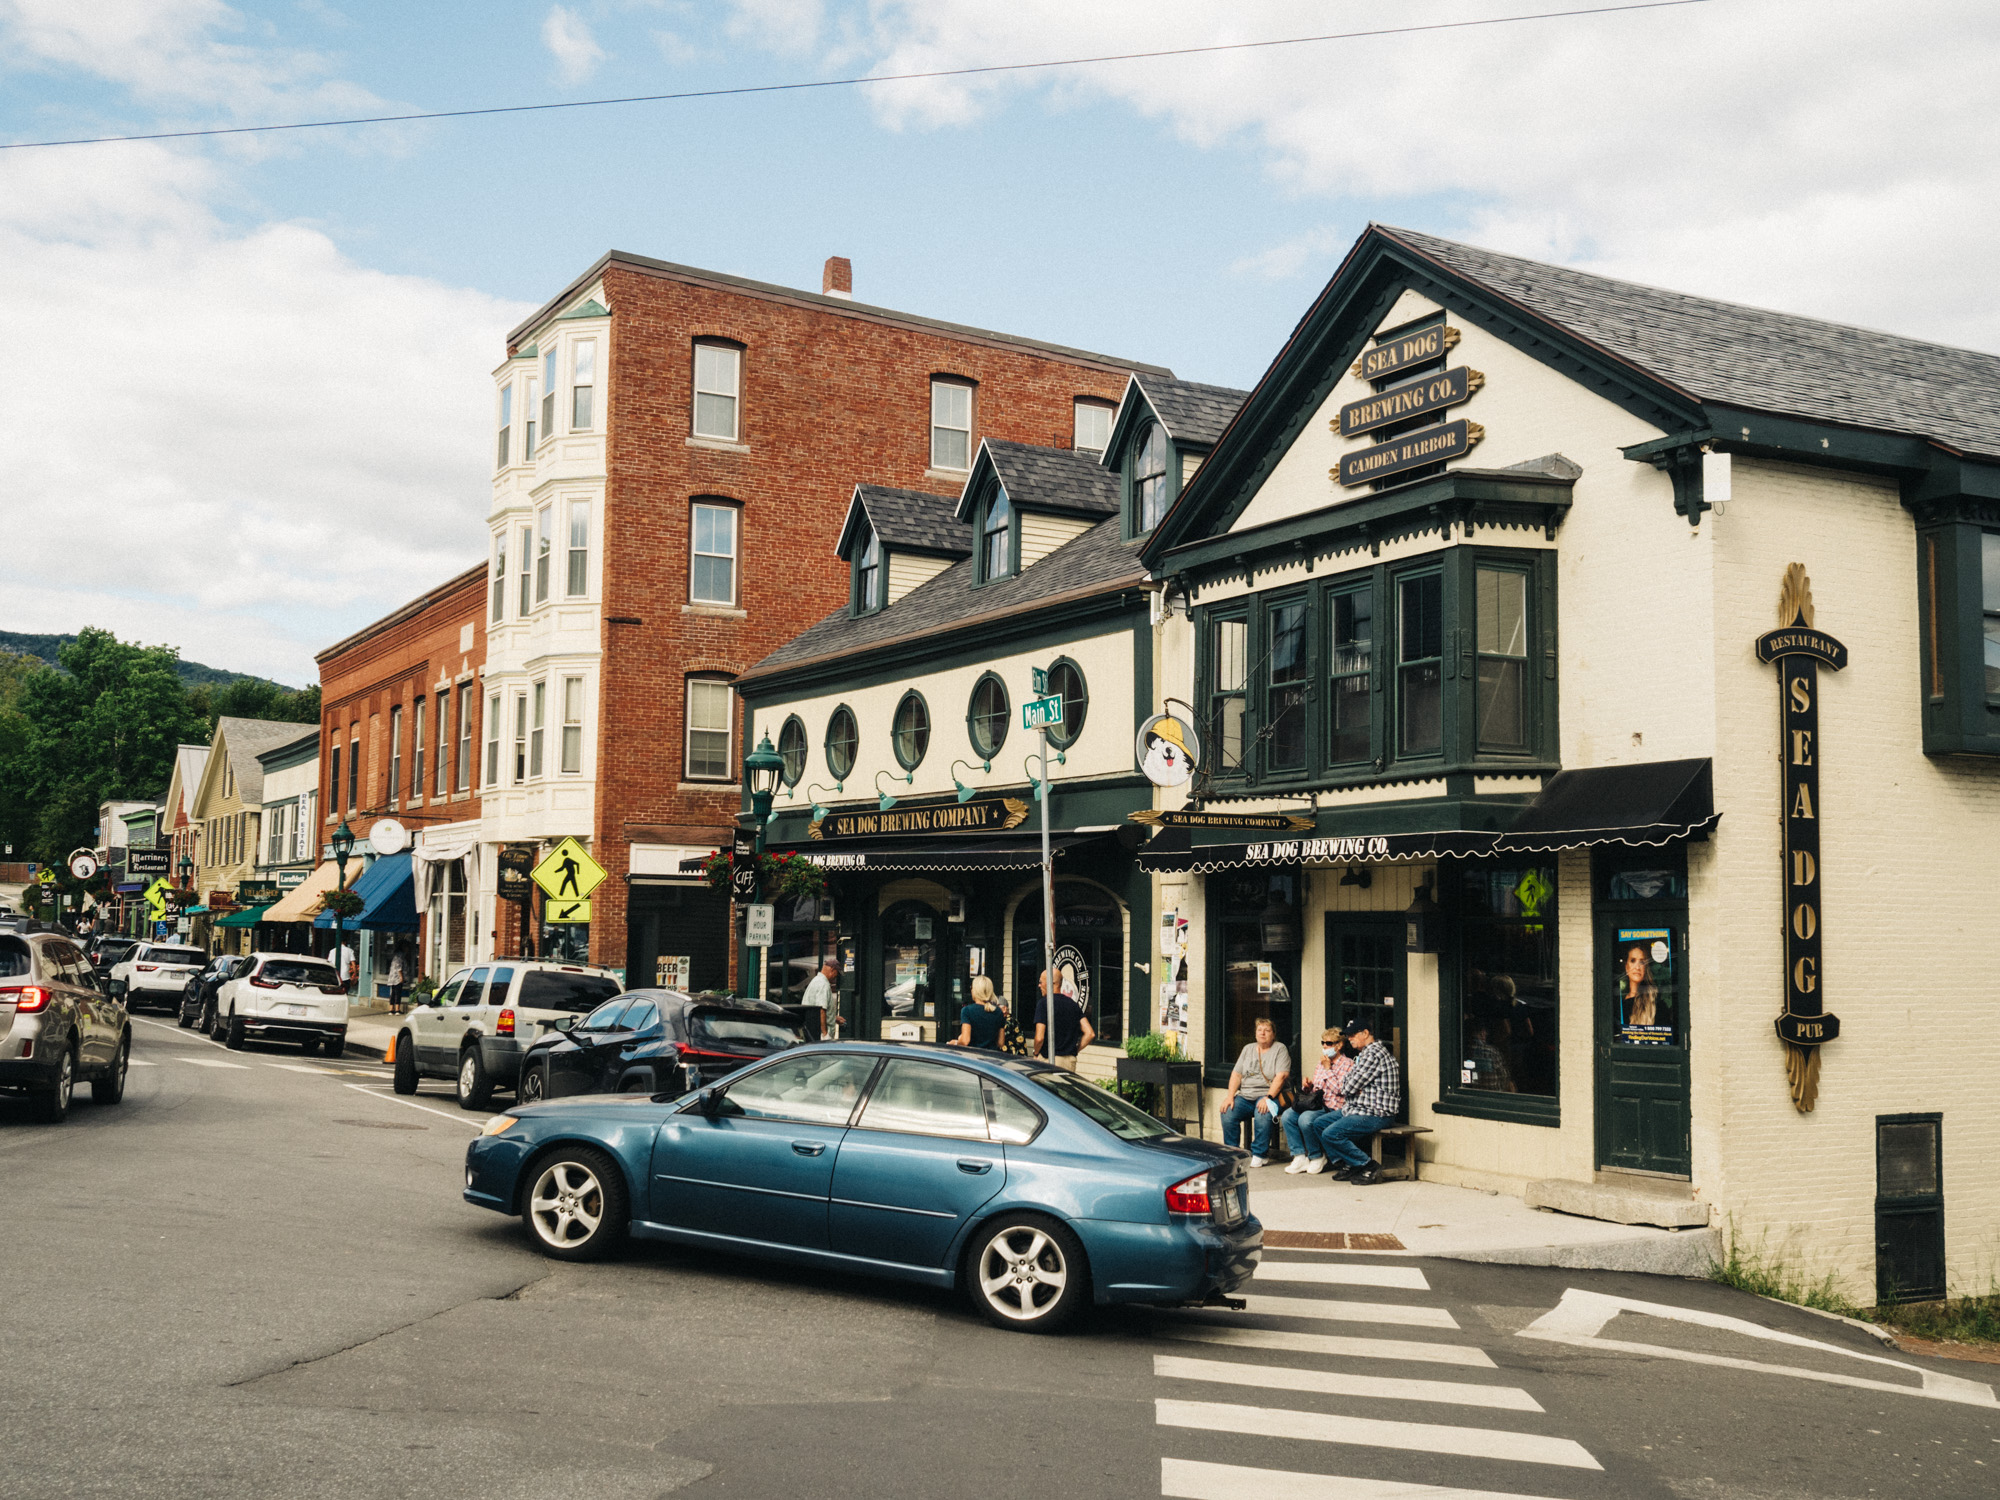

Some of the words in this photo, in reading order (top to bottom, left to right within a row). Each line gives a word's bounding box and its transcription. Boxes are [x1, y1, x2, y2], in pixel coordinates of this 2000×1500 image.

[1367, 347, 1398, 374] SEA
[1403, 332, 1438, 361] DOG
[1348, 386, 1424, 428] BREWING
[1429, 378, 1457, 402] CO.
[1348, 448, 1398, 475] CAMDEN
[1402, 431, 1456, 460] HARBOR
[1769, 634, 1840, 658] RESTAURANT
[1025, 704, 1045, 726] Main
[1049, 699, 1059, 721] St
[1790, 676, 1816, 819] SEA
[836, 817, 855, 835] SEA
[857, 815, 878, 834] DOG
[880, 810, 930, 832] BREWING
[932, 805, 989, 828] COMPANY
[1172, 814, 1188, 824] SEA
[1189, 815, 1206, 824] DOG
[1207, 816, 1243, 825] BREWING
[1244, 818, 1280, 827] COMPANY
[1245, 843, 1269, 860] SEA
[1272, 841, 1299, 858] DOG
[1301, 838, 1365, 857] BREWING
[1367, 837, 1390, 854] CO.
[131, 853, 168, 863] Marriner's
[812, 855, 825, 866] DOG
[826, 854, 855, 866] BREWING
[856, 854, 866, 866] CO.
[133, 862, 167, 871] Restaurant
[735, 871, 754, 885] CIFF
[756, 909, 766, 918] TWO
[753, 921, 767, 930] HOUR
[1792, 850, 1817, 994] DOG
[749, 932, 770, 941] PARKING
[1632, 930, 1668, 938] SOMETHING
[656, 963, 678, 973] BEER
[1796, 1022, 1823, 1038] PUB
